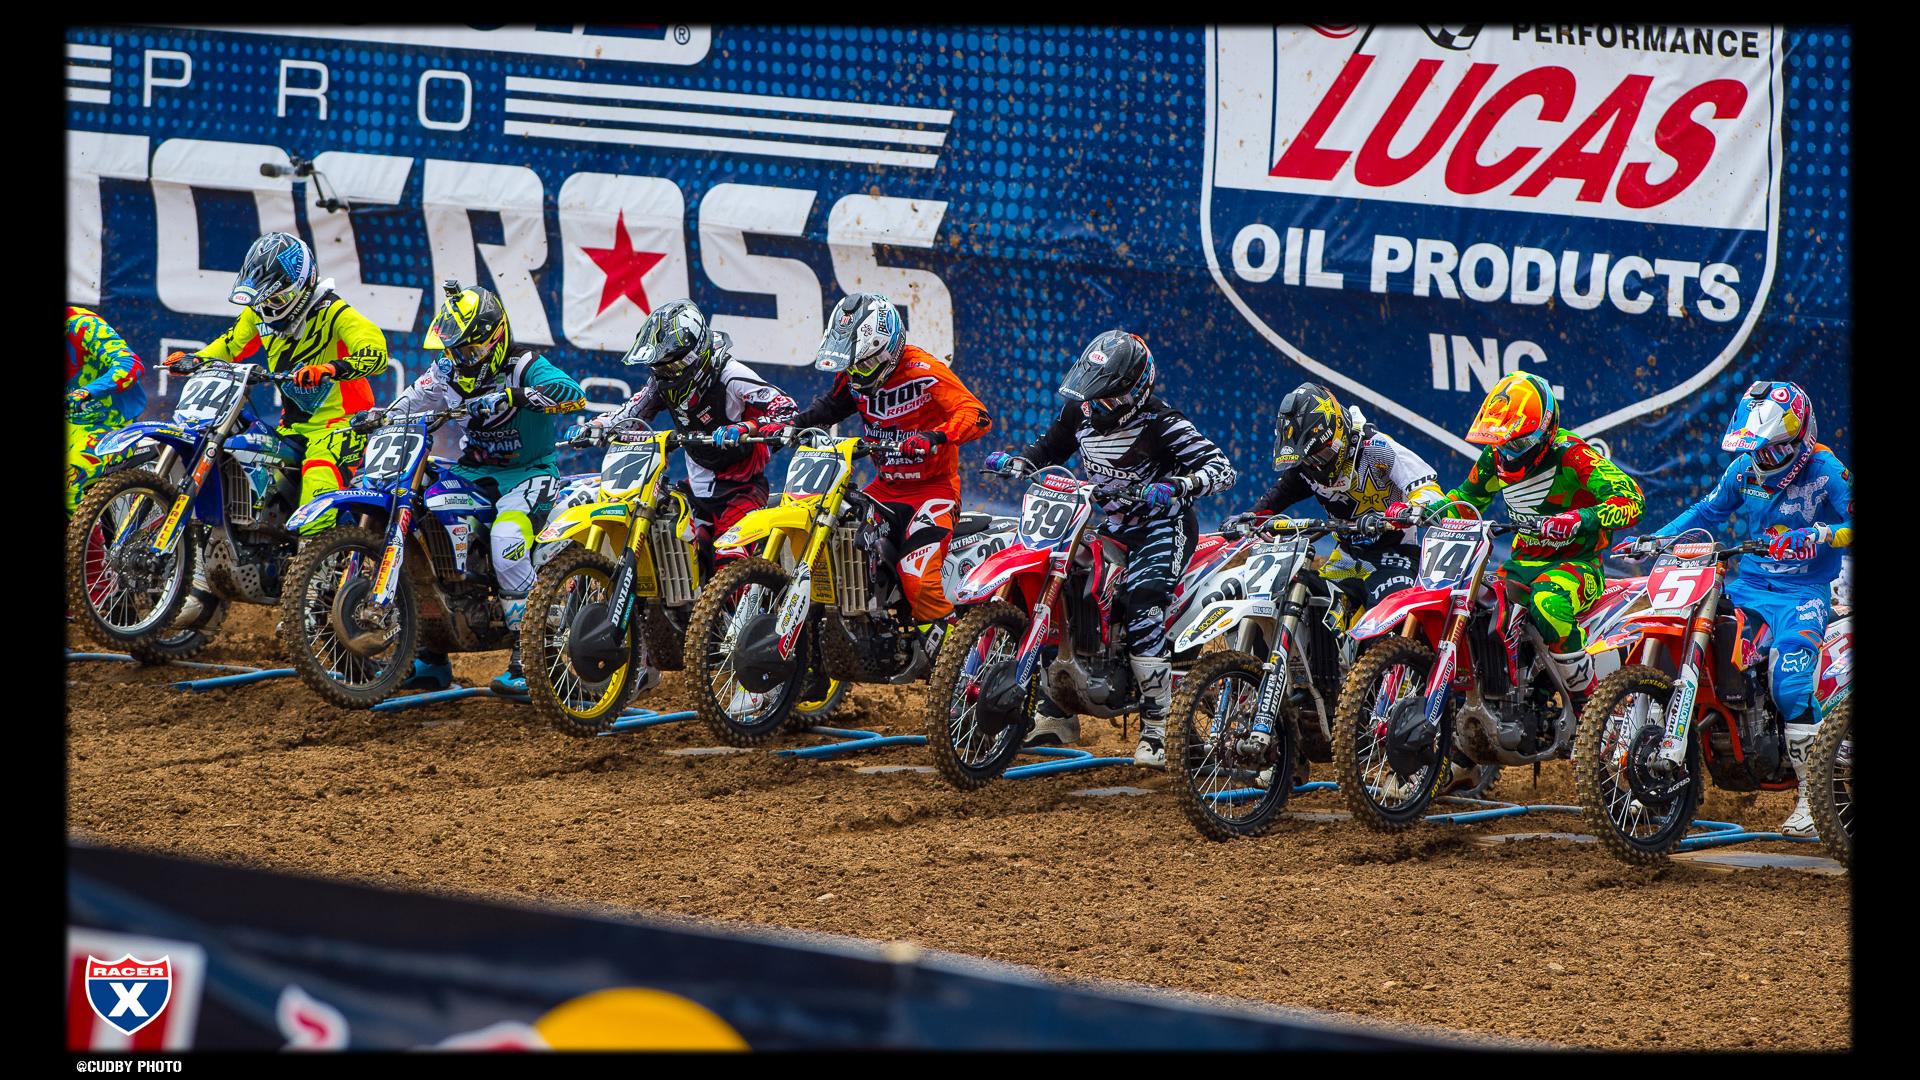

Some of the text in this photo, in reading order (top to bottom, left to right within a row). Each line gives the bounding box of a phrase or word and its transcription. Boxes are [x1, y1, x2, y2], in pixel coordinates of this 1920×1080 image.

[1512, 22, 1760, 59] PERFORMANCE
[1267, 53, 1749, 209] LUCAS
[1231, 223, 1742, 323] OIL PRODUCTS
[177, 380, 241, 417] 244
[294, 386, 319, 395] BLUE
[365, 434, 420, 473] 23
[895, 428, 919, 442] Eagl
[785, 458, 842, 495] 20
[1083, 458, 1142, 481] HONDA
[344, 489, 384, 499] TOYOTA
[1039, 490, 1069, 501] LUCAS OIL
[156, 495, 187, 548] PIRELLI
[1022, 499, 1073, 540] 39
[1437, 531, 1466, 540] LUCAS OIL
[1508, 509, 1537, 524] HON
[374, 547, 395, 592] PIRELLI
[1422, 540, 1472, 580] 14
[1674, 547, 1711, 555] RENTHAL
[1246, 554, 1296, 593] 21
[1655, 570, 1703, 609] 5
[611, 566, 633, 627] DUNLOP
[783, 595, 807, 650] DUNLOP
[1199, 607, 1226, 632] ROCKSTAR
[1261, 673, 1277, 712] GALFER
[1270, 663, 1287, 715] DUNLOP
[1679, 686, 1696, 724] MOTOREX
